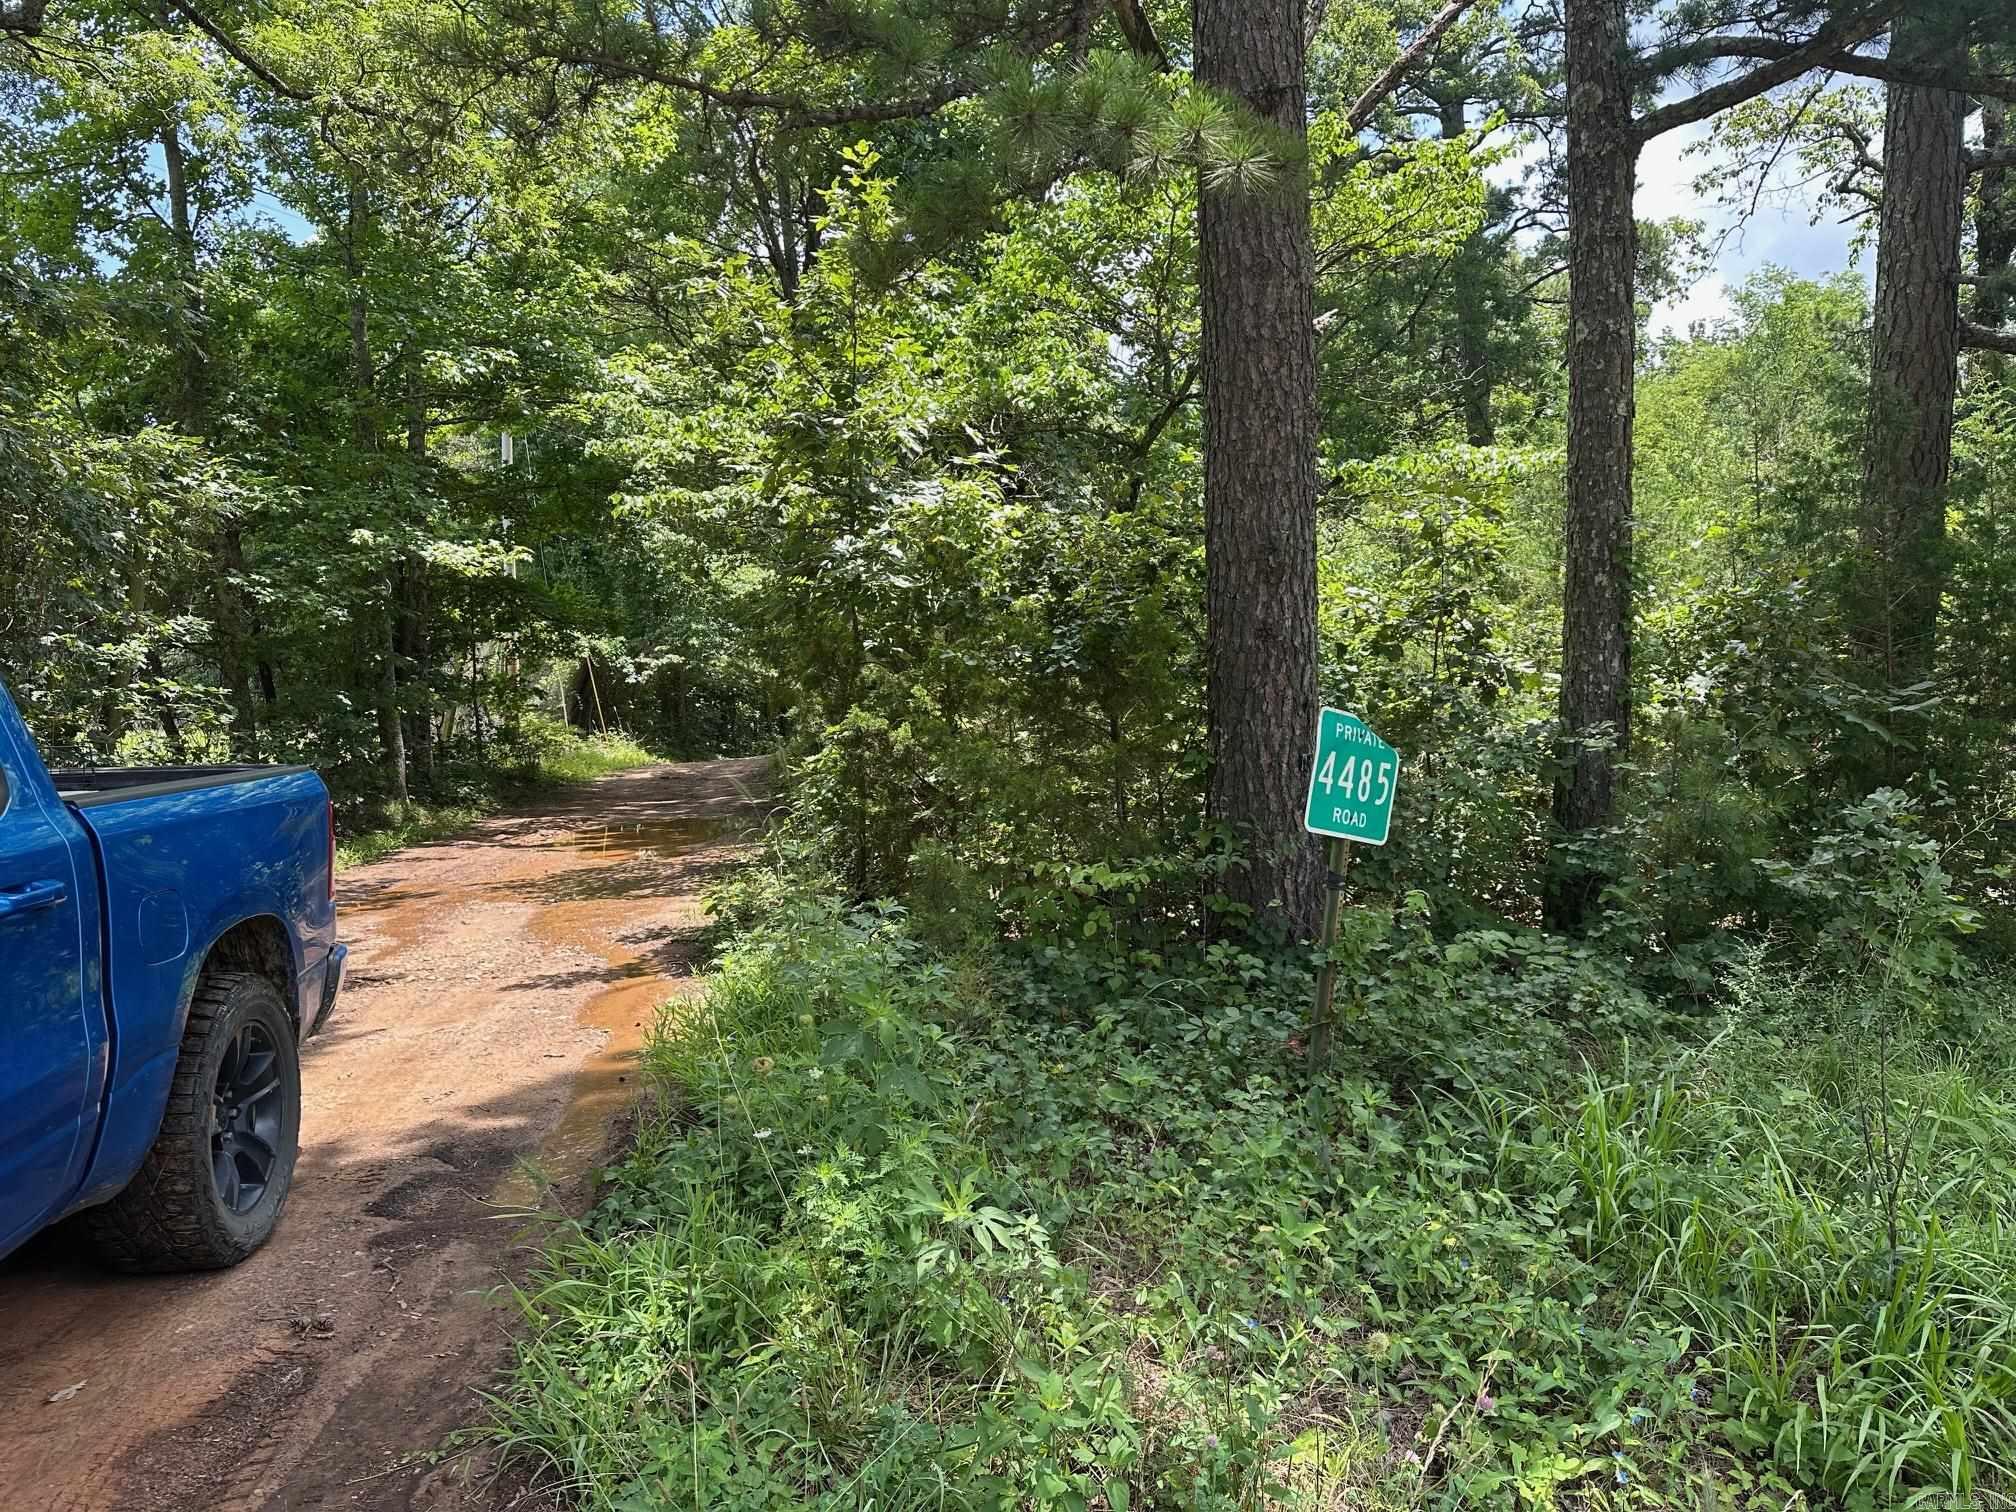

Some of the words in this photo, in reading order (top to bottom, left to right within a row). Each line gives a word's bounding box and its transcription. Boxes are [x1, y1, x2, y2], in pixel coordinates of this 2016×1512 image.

[1336, 723, 1385, 749] PRIVATE
[1318, 751, 1392, 805] 4485
[1333, 807, 1366, 828] ROAD
